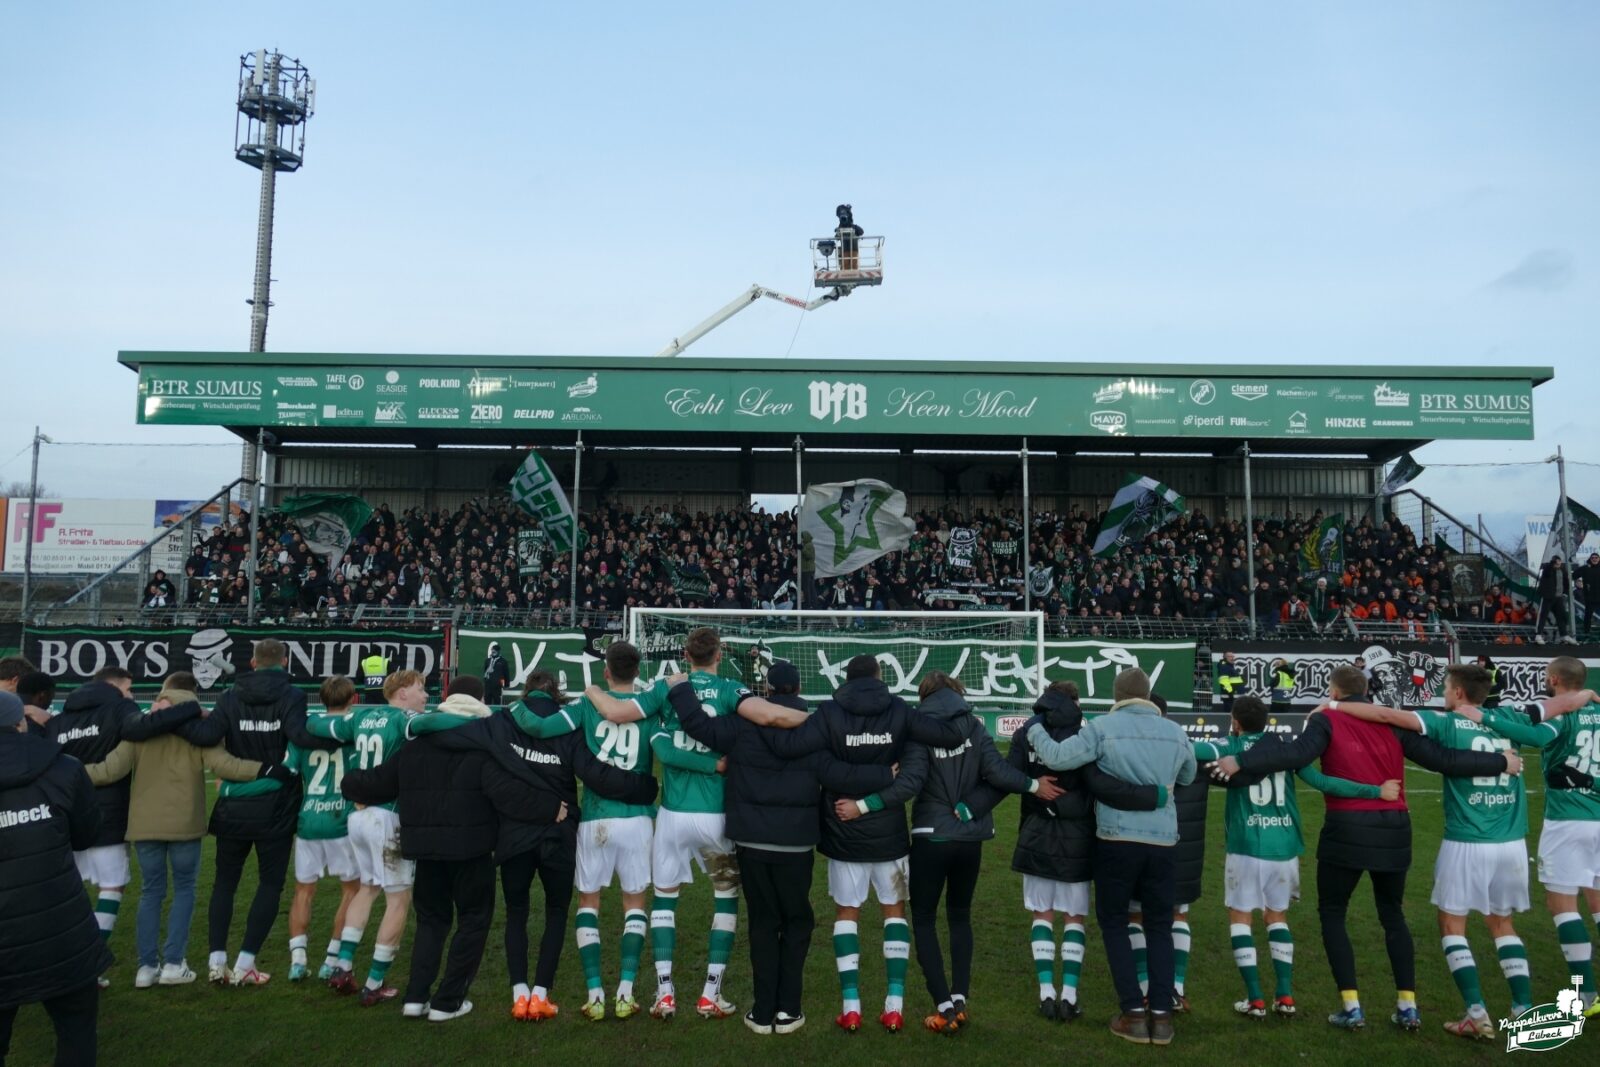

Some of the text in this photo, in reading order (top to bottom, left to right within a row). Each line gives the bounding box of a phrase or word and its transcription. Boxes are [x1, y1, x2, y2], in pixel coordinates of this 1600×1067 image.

[326, 374, 346, 383] TAFEL
[152, 380, 190, 395] BTR
[195, 381, 262, 396] SUMUS
[376, 385, 407, 393] SEASIDE
[1232, 384, 1268, 392] clement
[665, 388, 725, 417] Echt
[734, 387, 794, 417] Leev
[884, 388, 952, 418] Keen
[959, 387, 1038, 418] Mood
[1420, 394, 1458, 409] BTR
[1464, 395, 1530, 410] SUMUS
[513, 409, 555, 419] DELLPRO
[562, 413, 602, 421] JABLONKA
[1194, 415, 1224, 427] iperdi
[1325, 418, 1366, 428] HINZKE
[69, 528, 94, 536] Fritz
[38, 639, 169, 677] BOYS
[367, 677, 383, 685] 179
[595, 720, 640, 770] 29
[525, 748, 561, 765] Lübeck
[308, 750, 345, 796] 21
[314, 799, 346, 814] iperdi
[0, 803, 52, 828] übeck
[1258, 813, 1292, 829] iperdi
